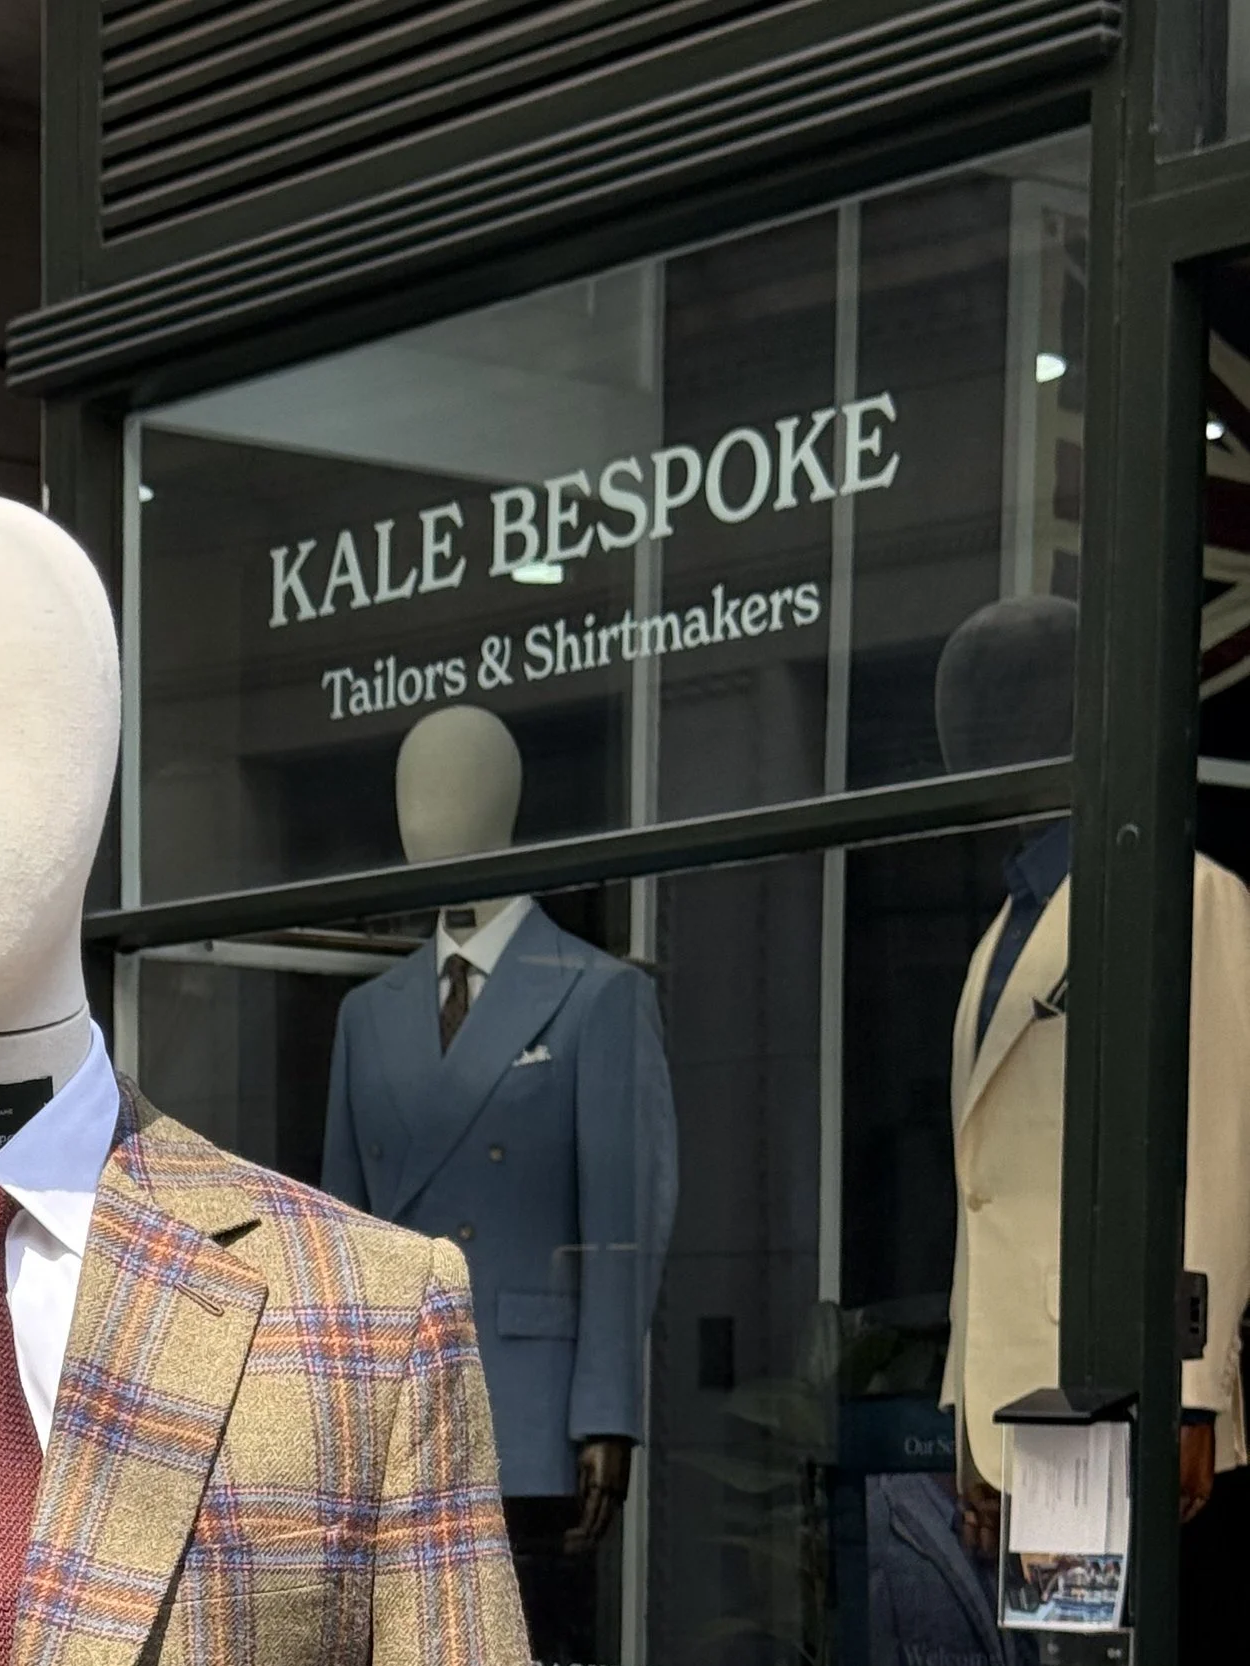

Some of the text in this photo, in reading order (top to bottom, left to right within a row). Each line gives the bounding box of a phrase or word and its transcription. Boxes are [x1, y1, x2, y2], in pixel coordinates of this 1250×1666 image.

[269, 392, 900, 628] KALE BESPOKE
[322, 582, 820, 720] Tailors & Shirtmakers
